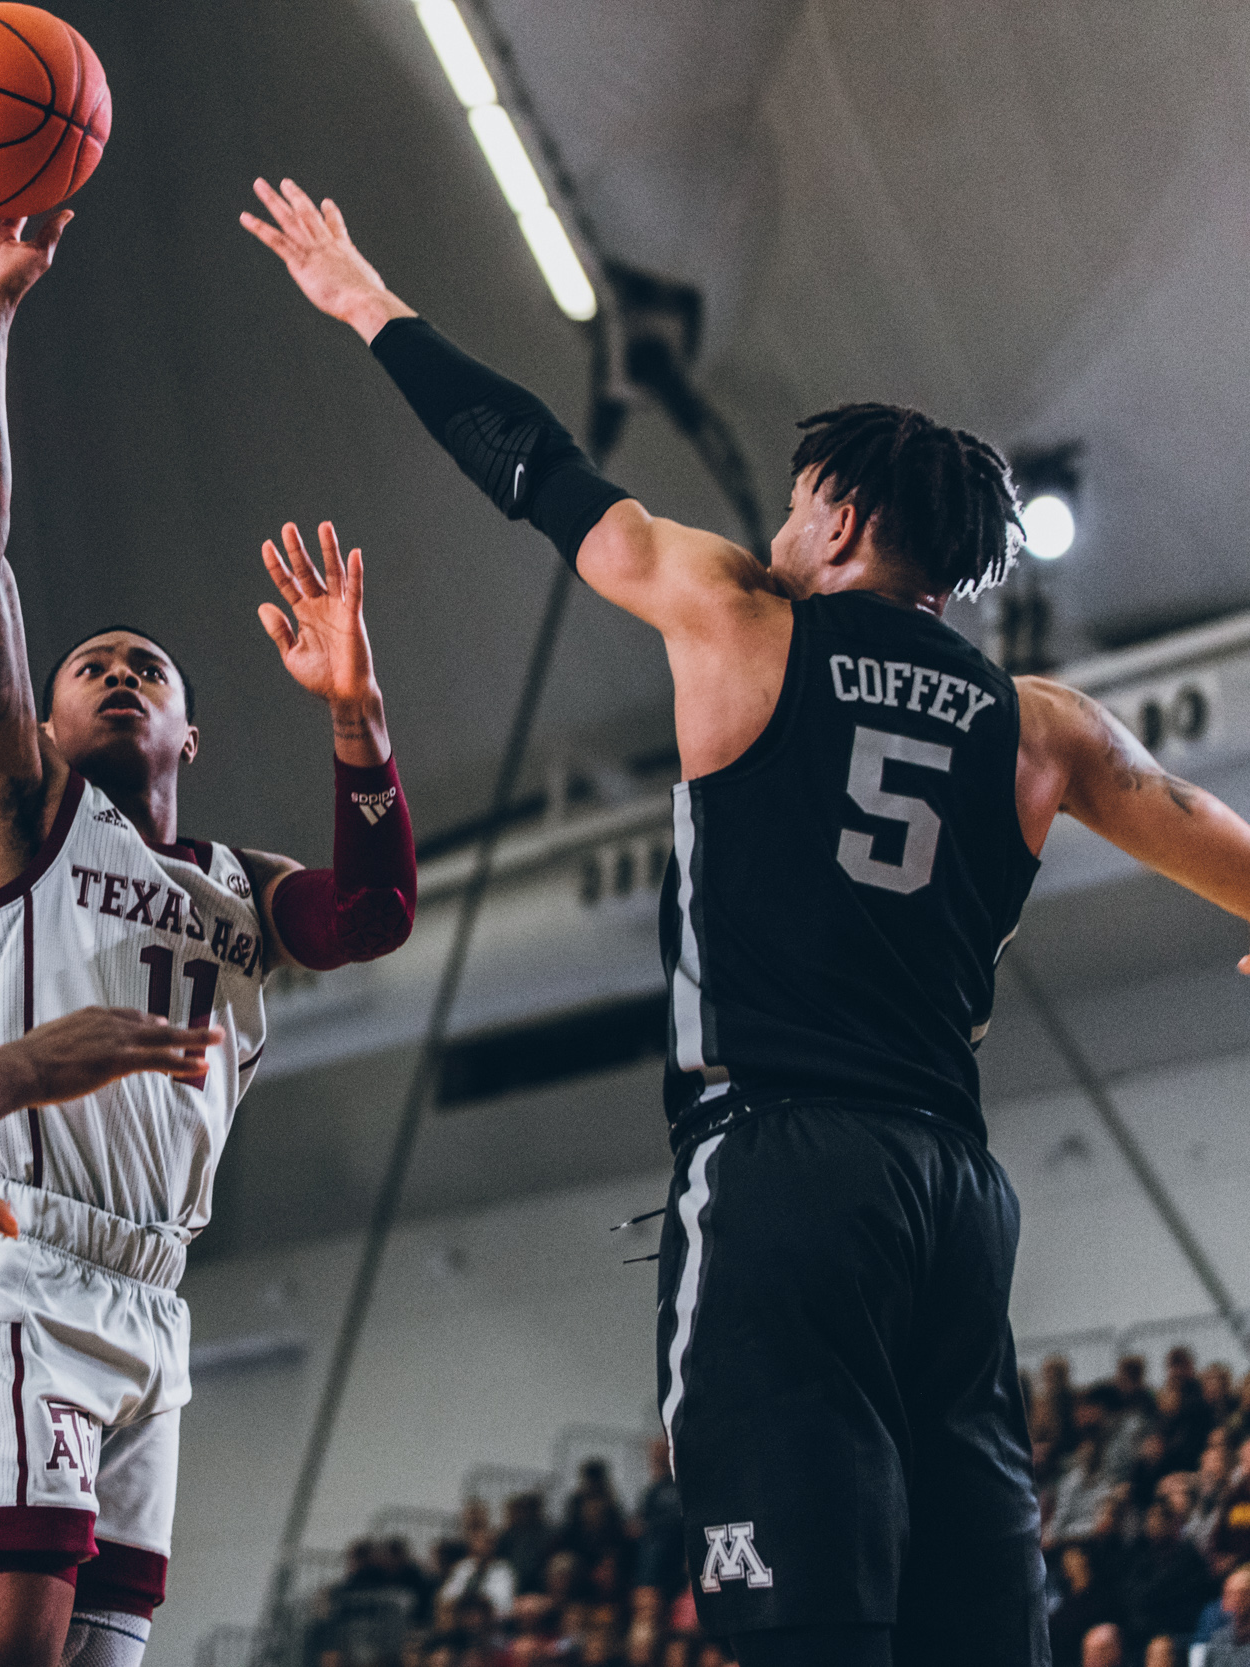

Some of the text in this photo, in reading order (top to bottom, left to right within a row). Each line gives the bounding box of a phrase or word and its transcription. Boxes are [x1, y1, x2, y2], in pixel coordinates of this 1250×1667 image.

[829, 654, 996, 733] COFFEY
[836, 725, 953, 894] 5
[71, 864, 205, 941] TEXAS
[700, 1521, 773, 1593] M
